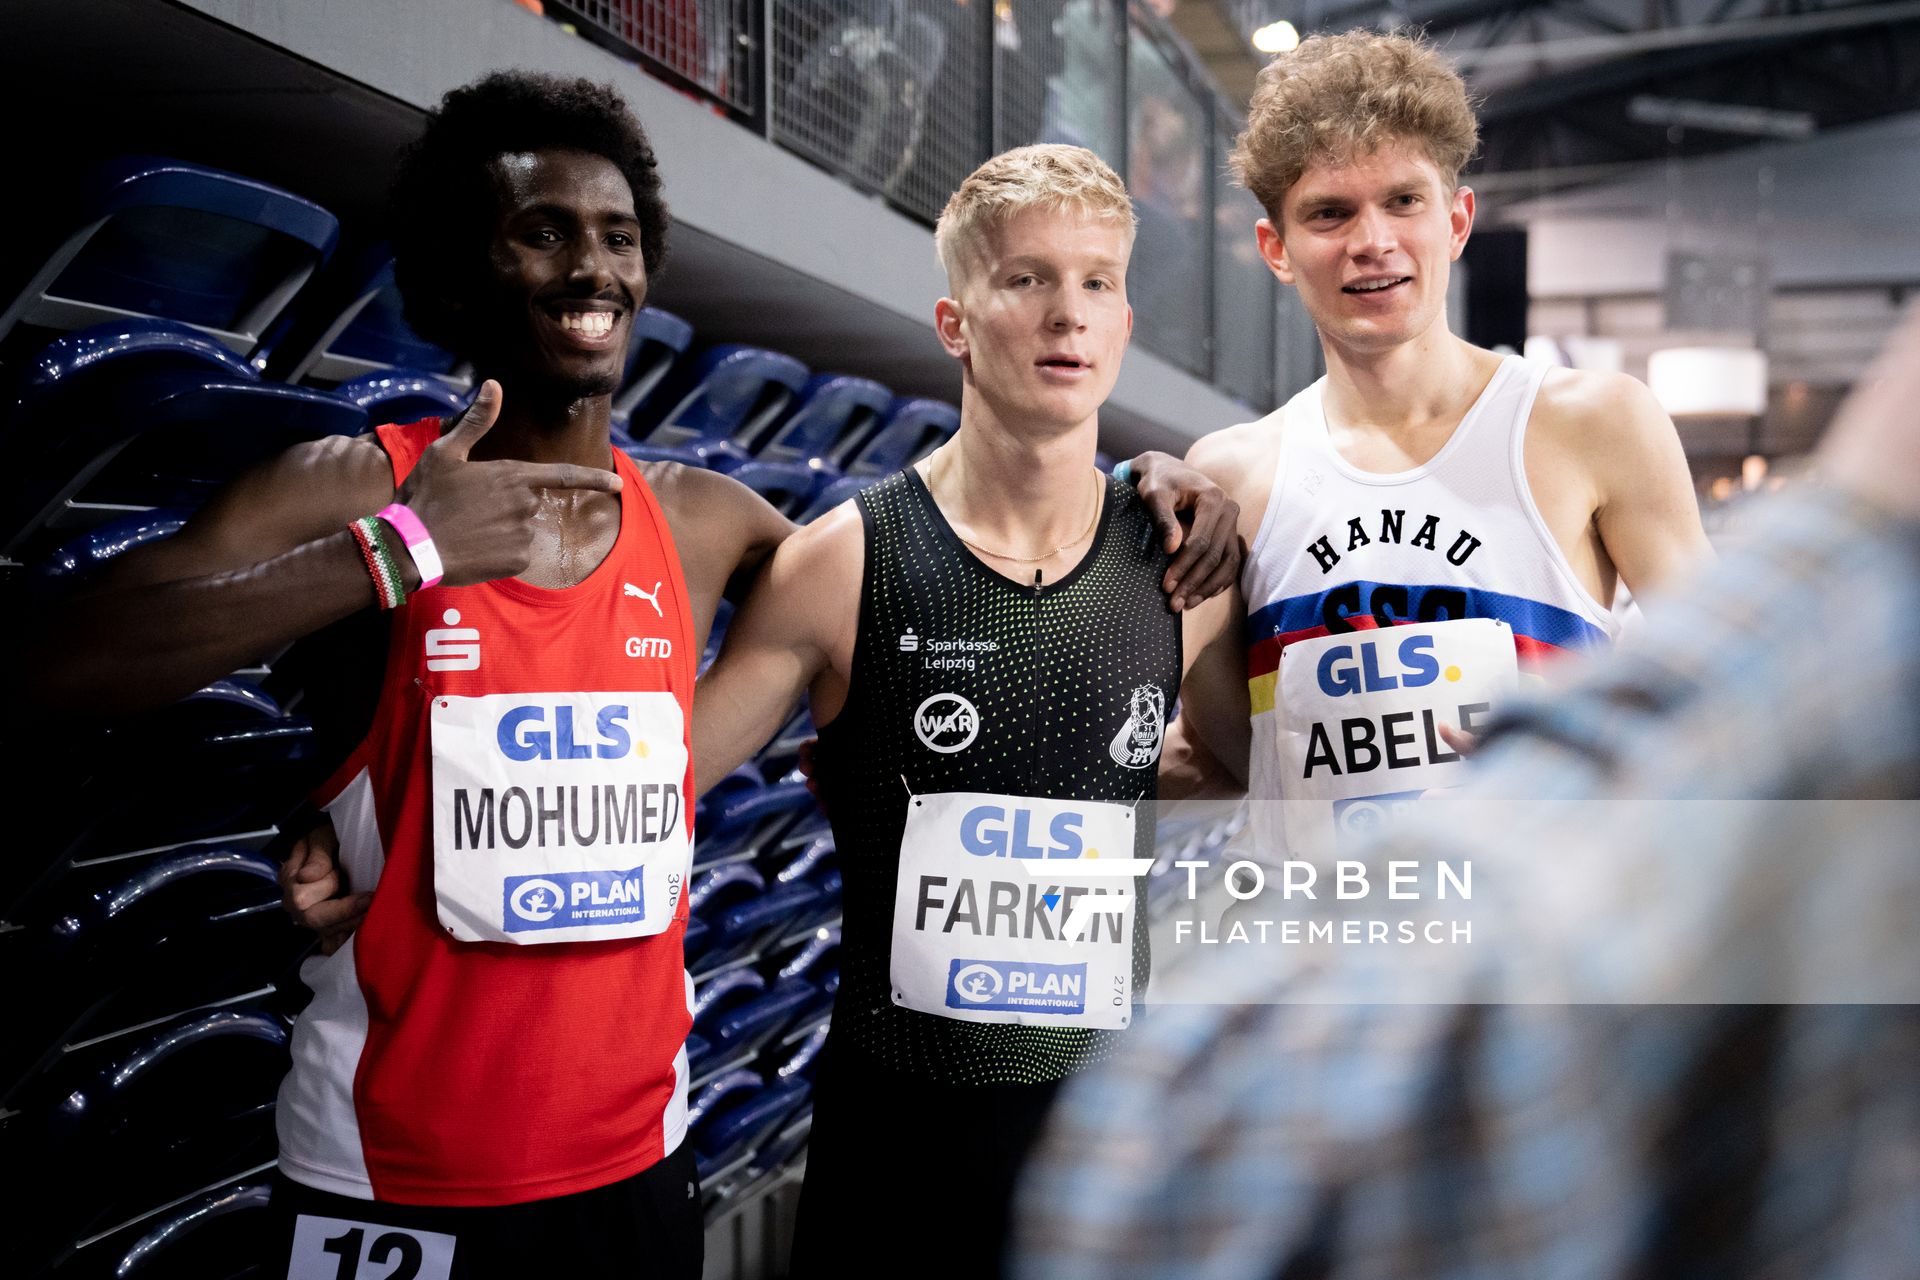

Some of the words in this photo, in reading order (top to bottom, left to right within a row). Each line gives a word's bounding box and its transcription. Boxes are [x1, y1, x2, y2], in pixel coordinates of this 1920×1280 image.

[1306, 509, 1482, 574] HANAU
[625, 636, 672, 659] GfTD
[926, 638, 998, 652] Sparkasse
[925, 658, 976, 671] Leipzig
[921, 714, 973, 732] WAR
[454, 783, 680, 850] MOHUMED
[571, 878, 640, 906] PLAN
[571, 905, 640, 919] INTERNATIONAL
[915, 875, 1124, 944] FARKEN
[1008, 972, 1080, 996] PLAN
[1112, 975, 1124, 1006] 270
[1007, 997, 1079, 1008] INTERNATIONAL
